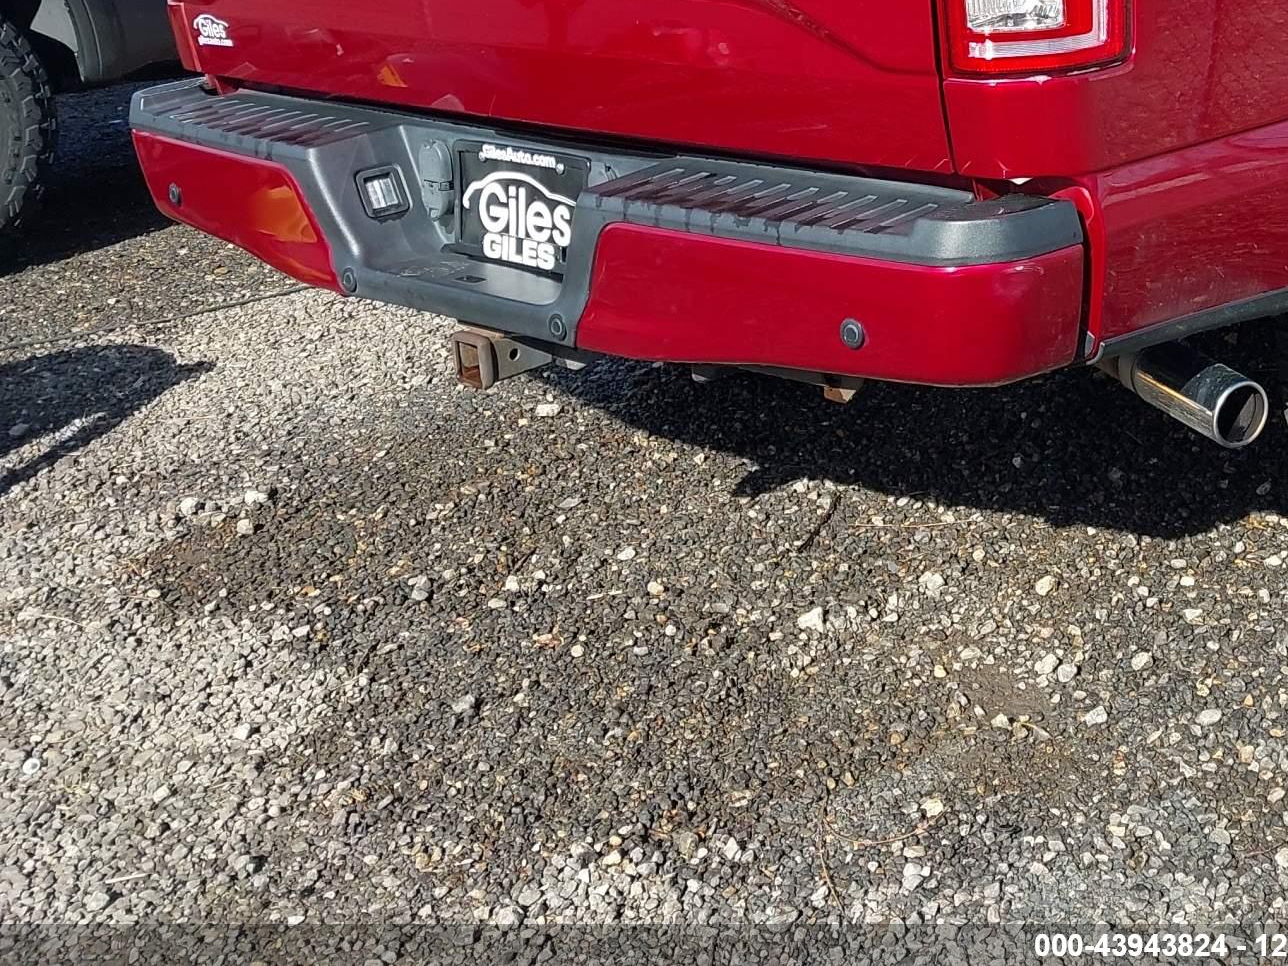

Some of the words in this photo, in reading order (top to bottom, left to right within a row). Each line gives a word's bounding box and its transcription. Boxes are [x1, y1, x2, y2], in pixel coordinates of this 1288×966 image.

[199, 19, 227, 39] Giles
[482, 143, 556, 169] GilesAuto.com
[479, 182, 571, 247] Giles
[483, 232, 555, 271] GILES
